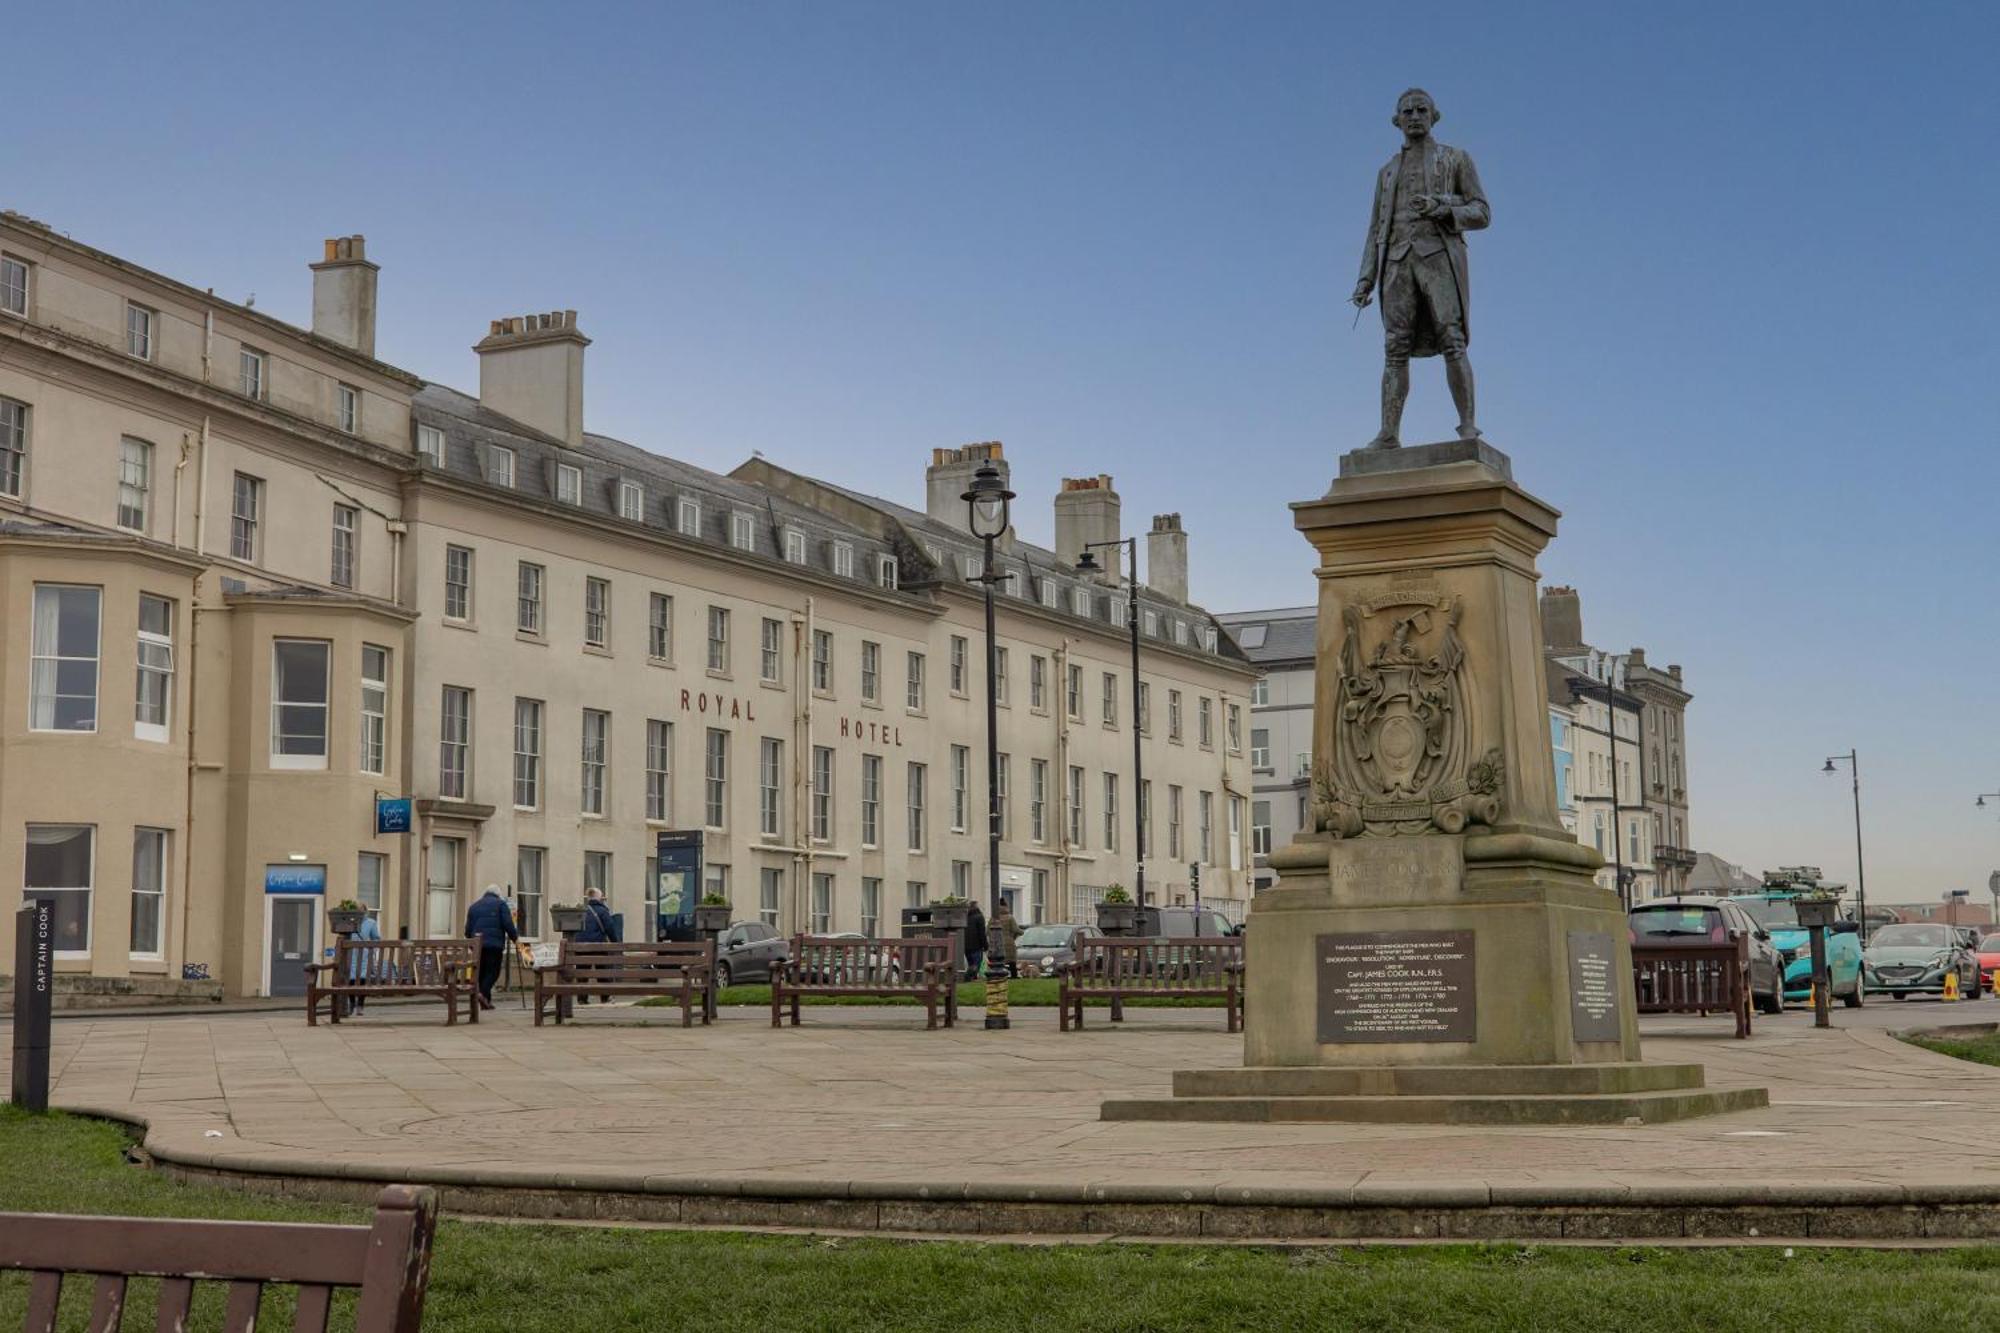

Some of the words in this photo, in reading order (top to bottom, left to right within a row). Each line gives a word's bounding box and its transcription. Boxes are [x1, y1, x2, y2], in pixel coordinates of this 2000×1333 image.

[681, 689, 755, 721] ROYAL
[840, 717, 902, 746] HOTEL
[39, 906, 48, 938] COOK
[36, 943, 48, 992] CAPTAIN
